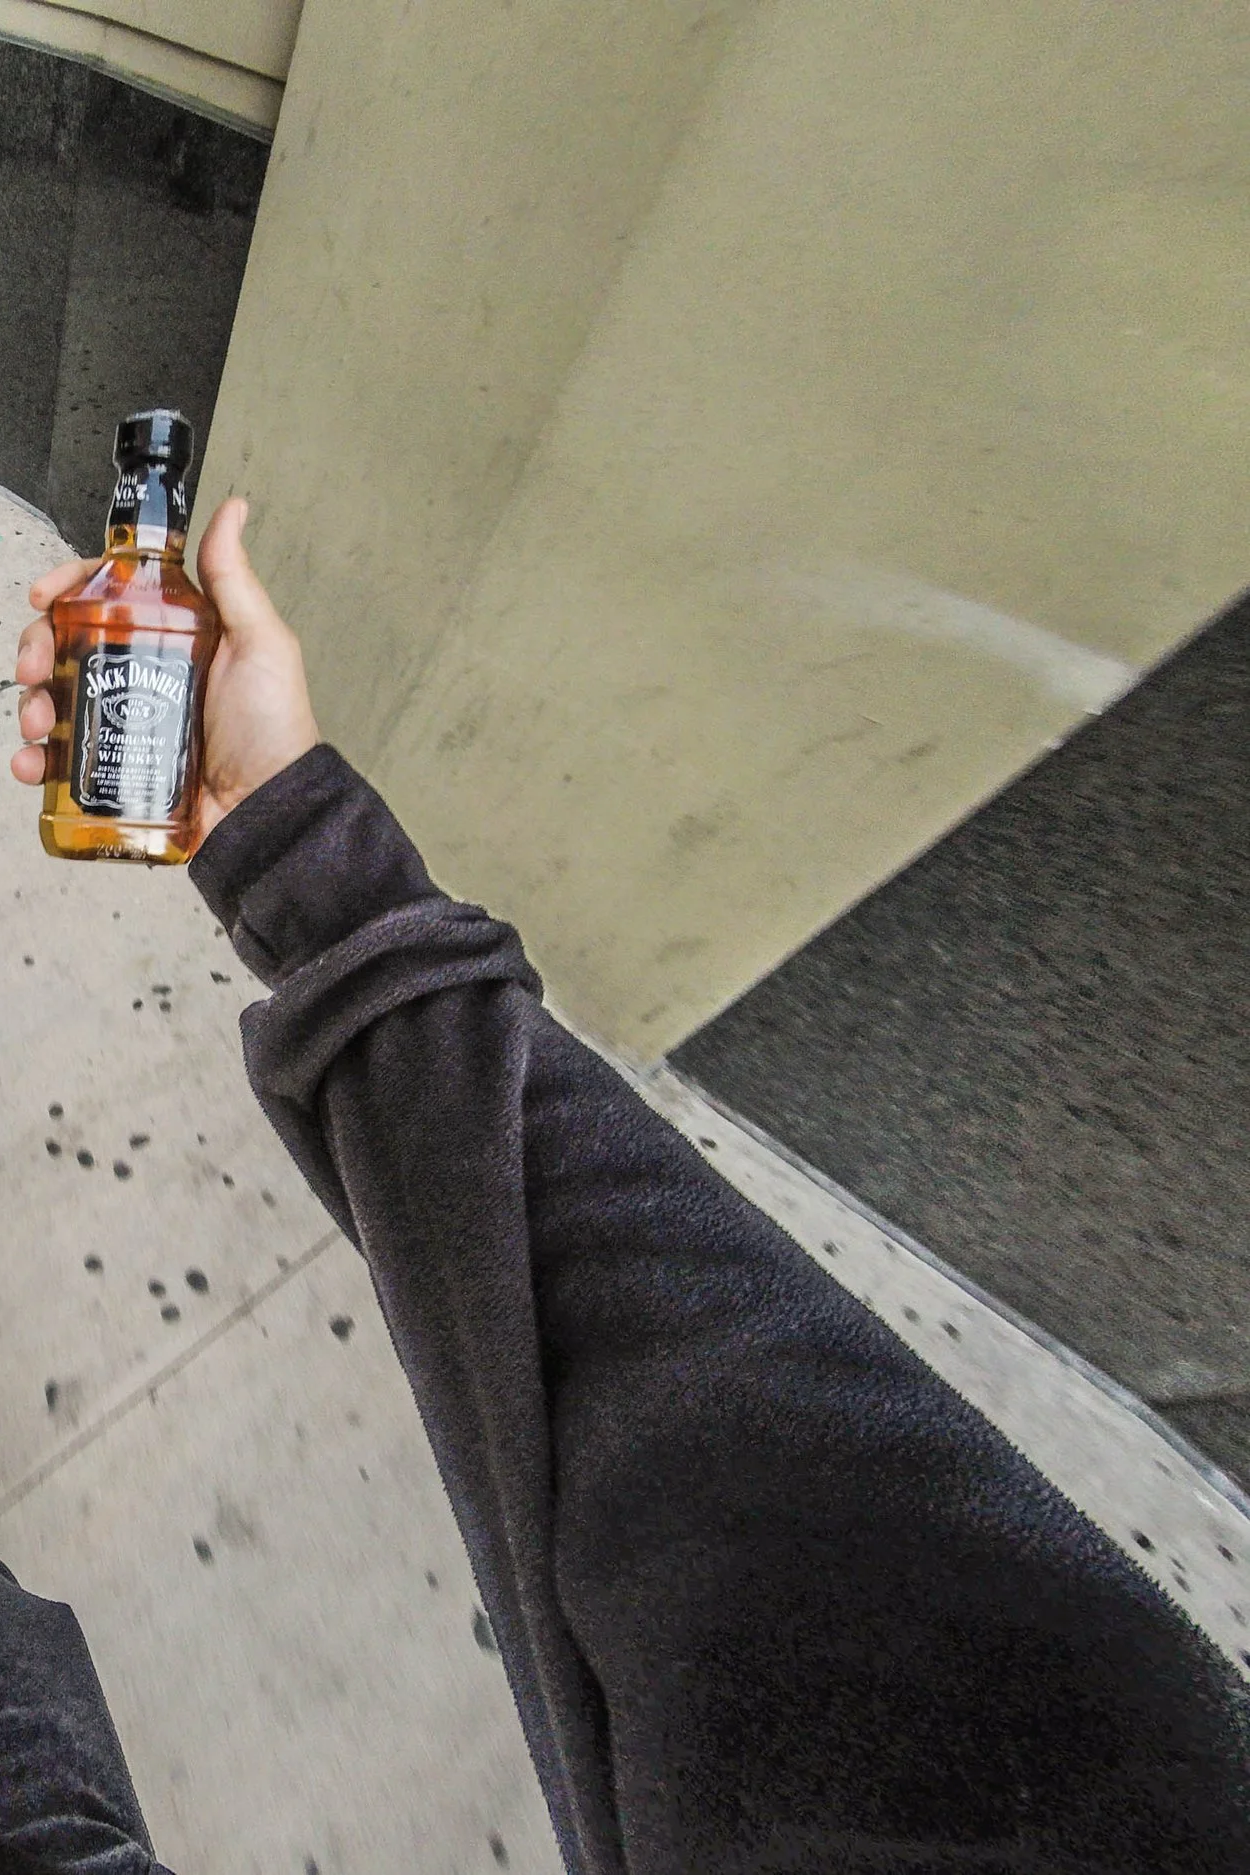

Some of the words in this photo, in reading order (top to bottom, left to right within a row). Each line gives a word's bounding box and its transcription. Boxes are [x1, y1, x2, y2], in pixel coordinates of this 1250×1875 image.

[86, 666, 127, 698] JACK
[98, 726, 166, 746] Tennessee
[98, 750, 164, 766] WHISKEY
